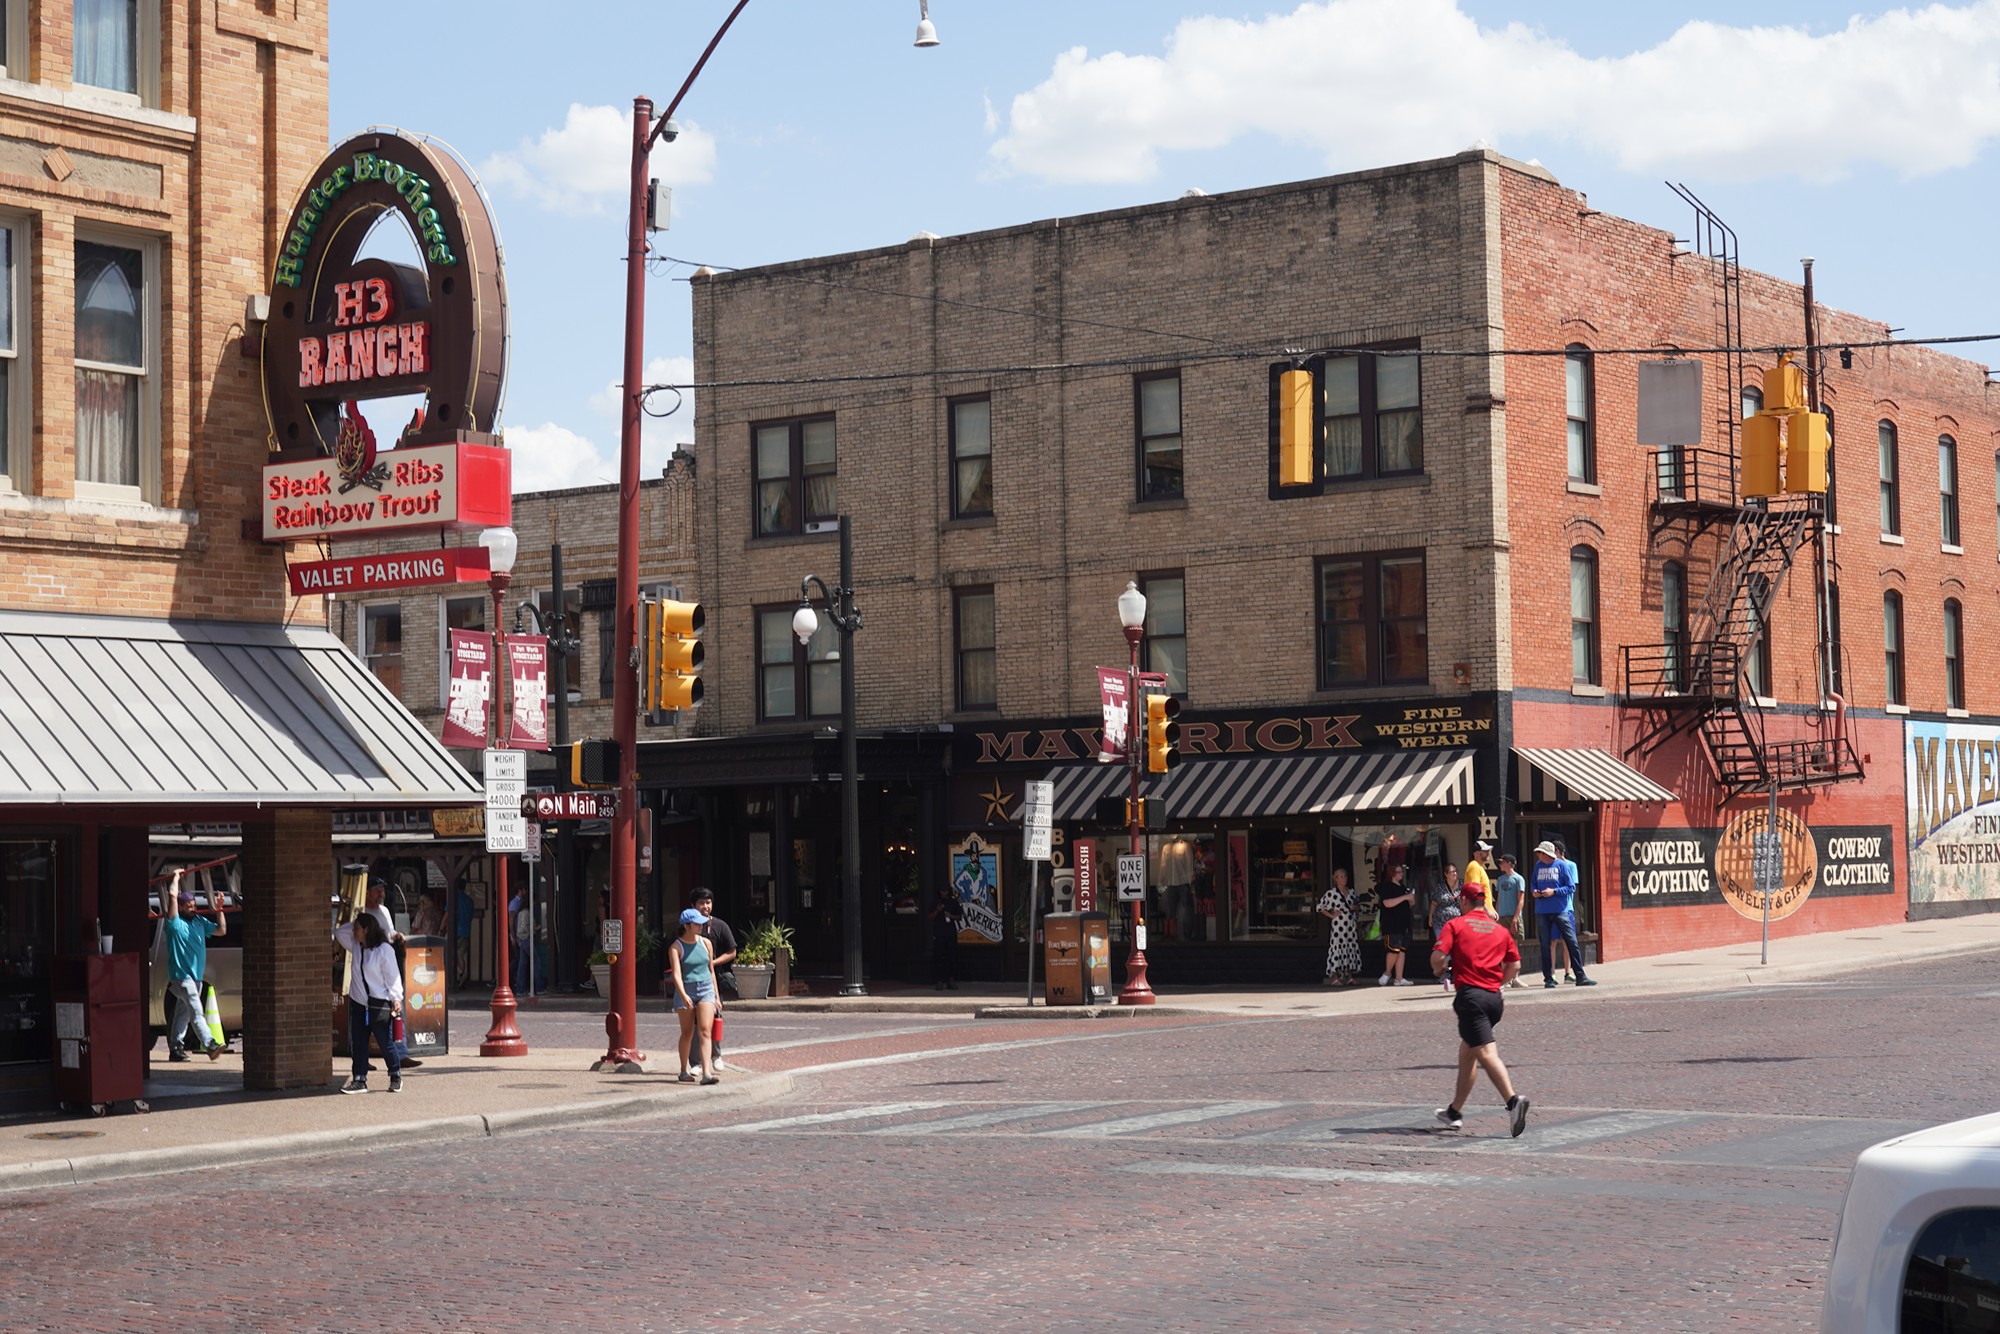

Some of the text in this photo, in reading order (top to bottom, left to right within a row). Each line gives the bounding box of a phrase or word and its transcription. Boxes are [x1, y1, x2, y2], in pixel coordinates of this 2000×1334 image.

[276, 152, 457, 288] Hunter Brothers
[335, 278, 393, 326] H3
[299, 321, 430, 388] RANCH
[267, 459, 443, 500] Steak Ribs
[273, 489, 442, 530] Rainbow Trout
[299, 557, 445, 589] VALET PARKING
[1403, 706, 1462, 720] FINE
[975, 714, 1363, 762] MAVRICK
[1375, 719, 1492, 736] WESTERN
[1398, 734, 1469, 748] WEAR
[494, 755, 516, 764] WEIGHT
[495, 769, 515, 777] LIMITS
[496, 783, 516, 792] GROSS
[1913, 736, 2000, 849] MAVE
[495, 812, 518, 820] TANDEM
[555, 795, 610, 815] N Main St
[598, 807, 615, 817] 2450
[499, 824, 514, 832] AXLE
[1974, 815, 2000, 834] FIN
[1630, 840, 1705, 866] COWGIRL
[1828, 836, 1882, 860] COWBOY
[1080, 846, 1090, 897] HISTORIC
[1119, 872, 1142, 884] WAY
[1120, 860, 1142, 872] ONE
[1822, 863, 1890, 887] CLOTHING
[1627, 868, 1710, 896] CLOTHING
[1775, 896, 1783, 909] &
[1784, 866, 1813, 905] GIFTS
